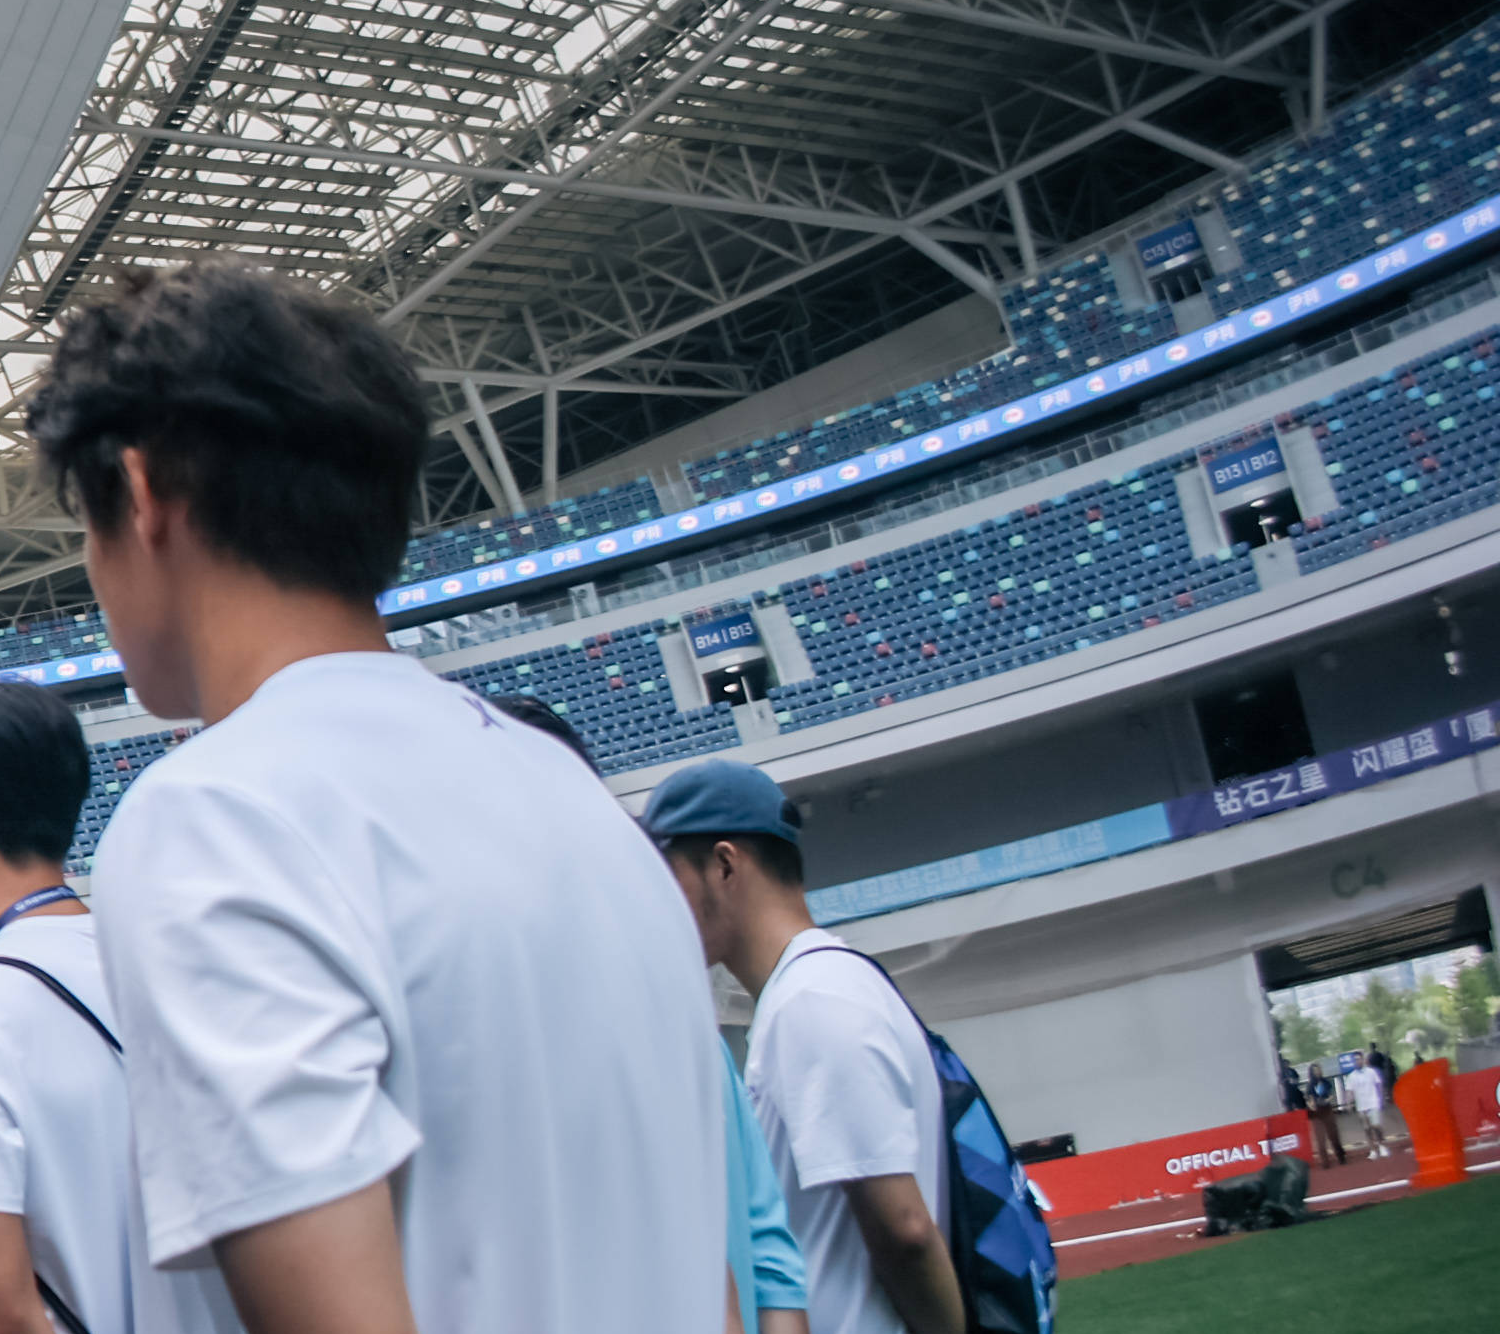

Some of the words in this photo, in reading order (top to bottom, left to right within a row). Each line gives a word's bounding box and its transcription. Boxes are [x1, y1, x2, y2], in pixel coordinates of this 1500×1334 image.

[1214, 463, 1239, 485] B13
[1251, 449, 1278, 471] B12
[694, 632, 719, 650] B14
[730, 622, 753, 640] B13
[1214, 762, 1327, 817] 钻石之星
[1165, 1144, 1257, 1175] OFFICIAL
